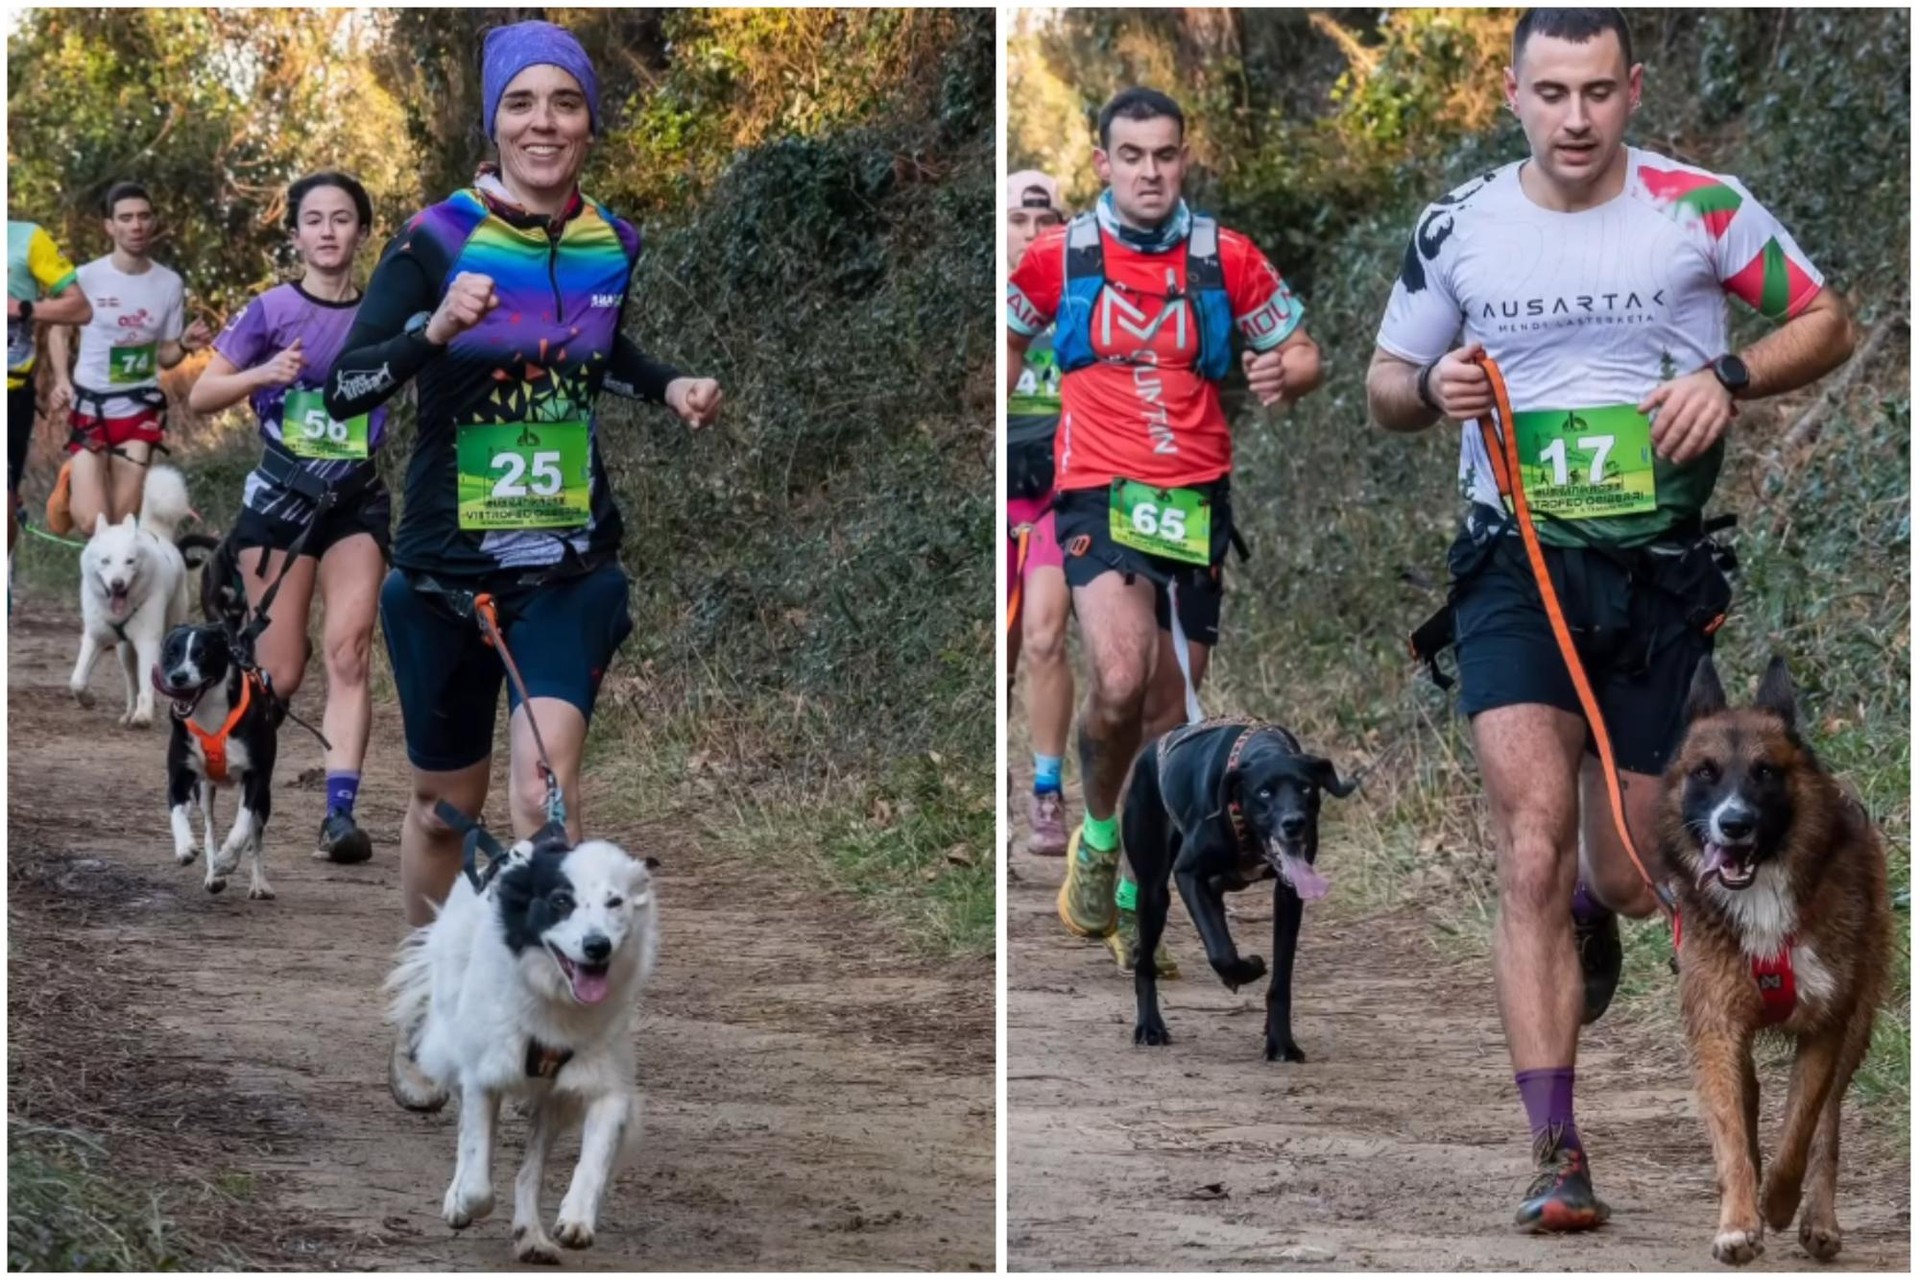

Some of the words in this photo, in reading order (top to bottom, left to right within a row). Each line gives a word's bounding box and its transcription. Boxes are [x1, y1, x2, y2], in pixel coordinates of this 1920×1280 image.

[1483, 289, 1665, 318] AUSARTAK
[122, 353, 149, 374] 74
[303, 409, 348, 442] 56
[490, 451, 563, 498] 25
[1540, 434, 1616, 486] 17
[1131, 502, 1186, 542] 65
